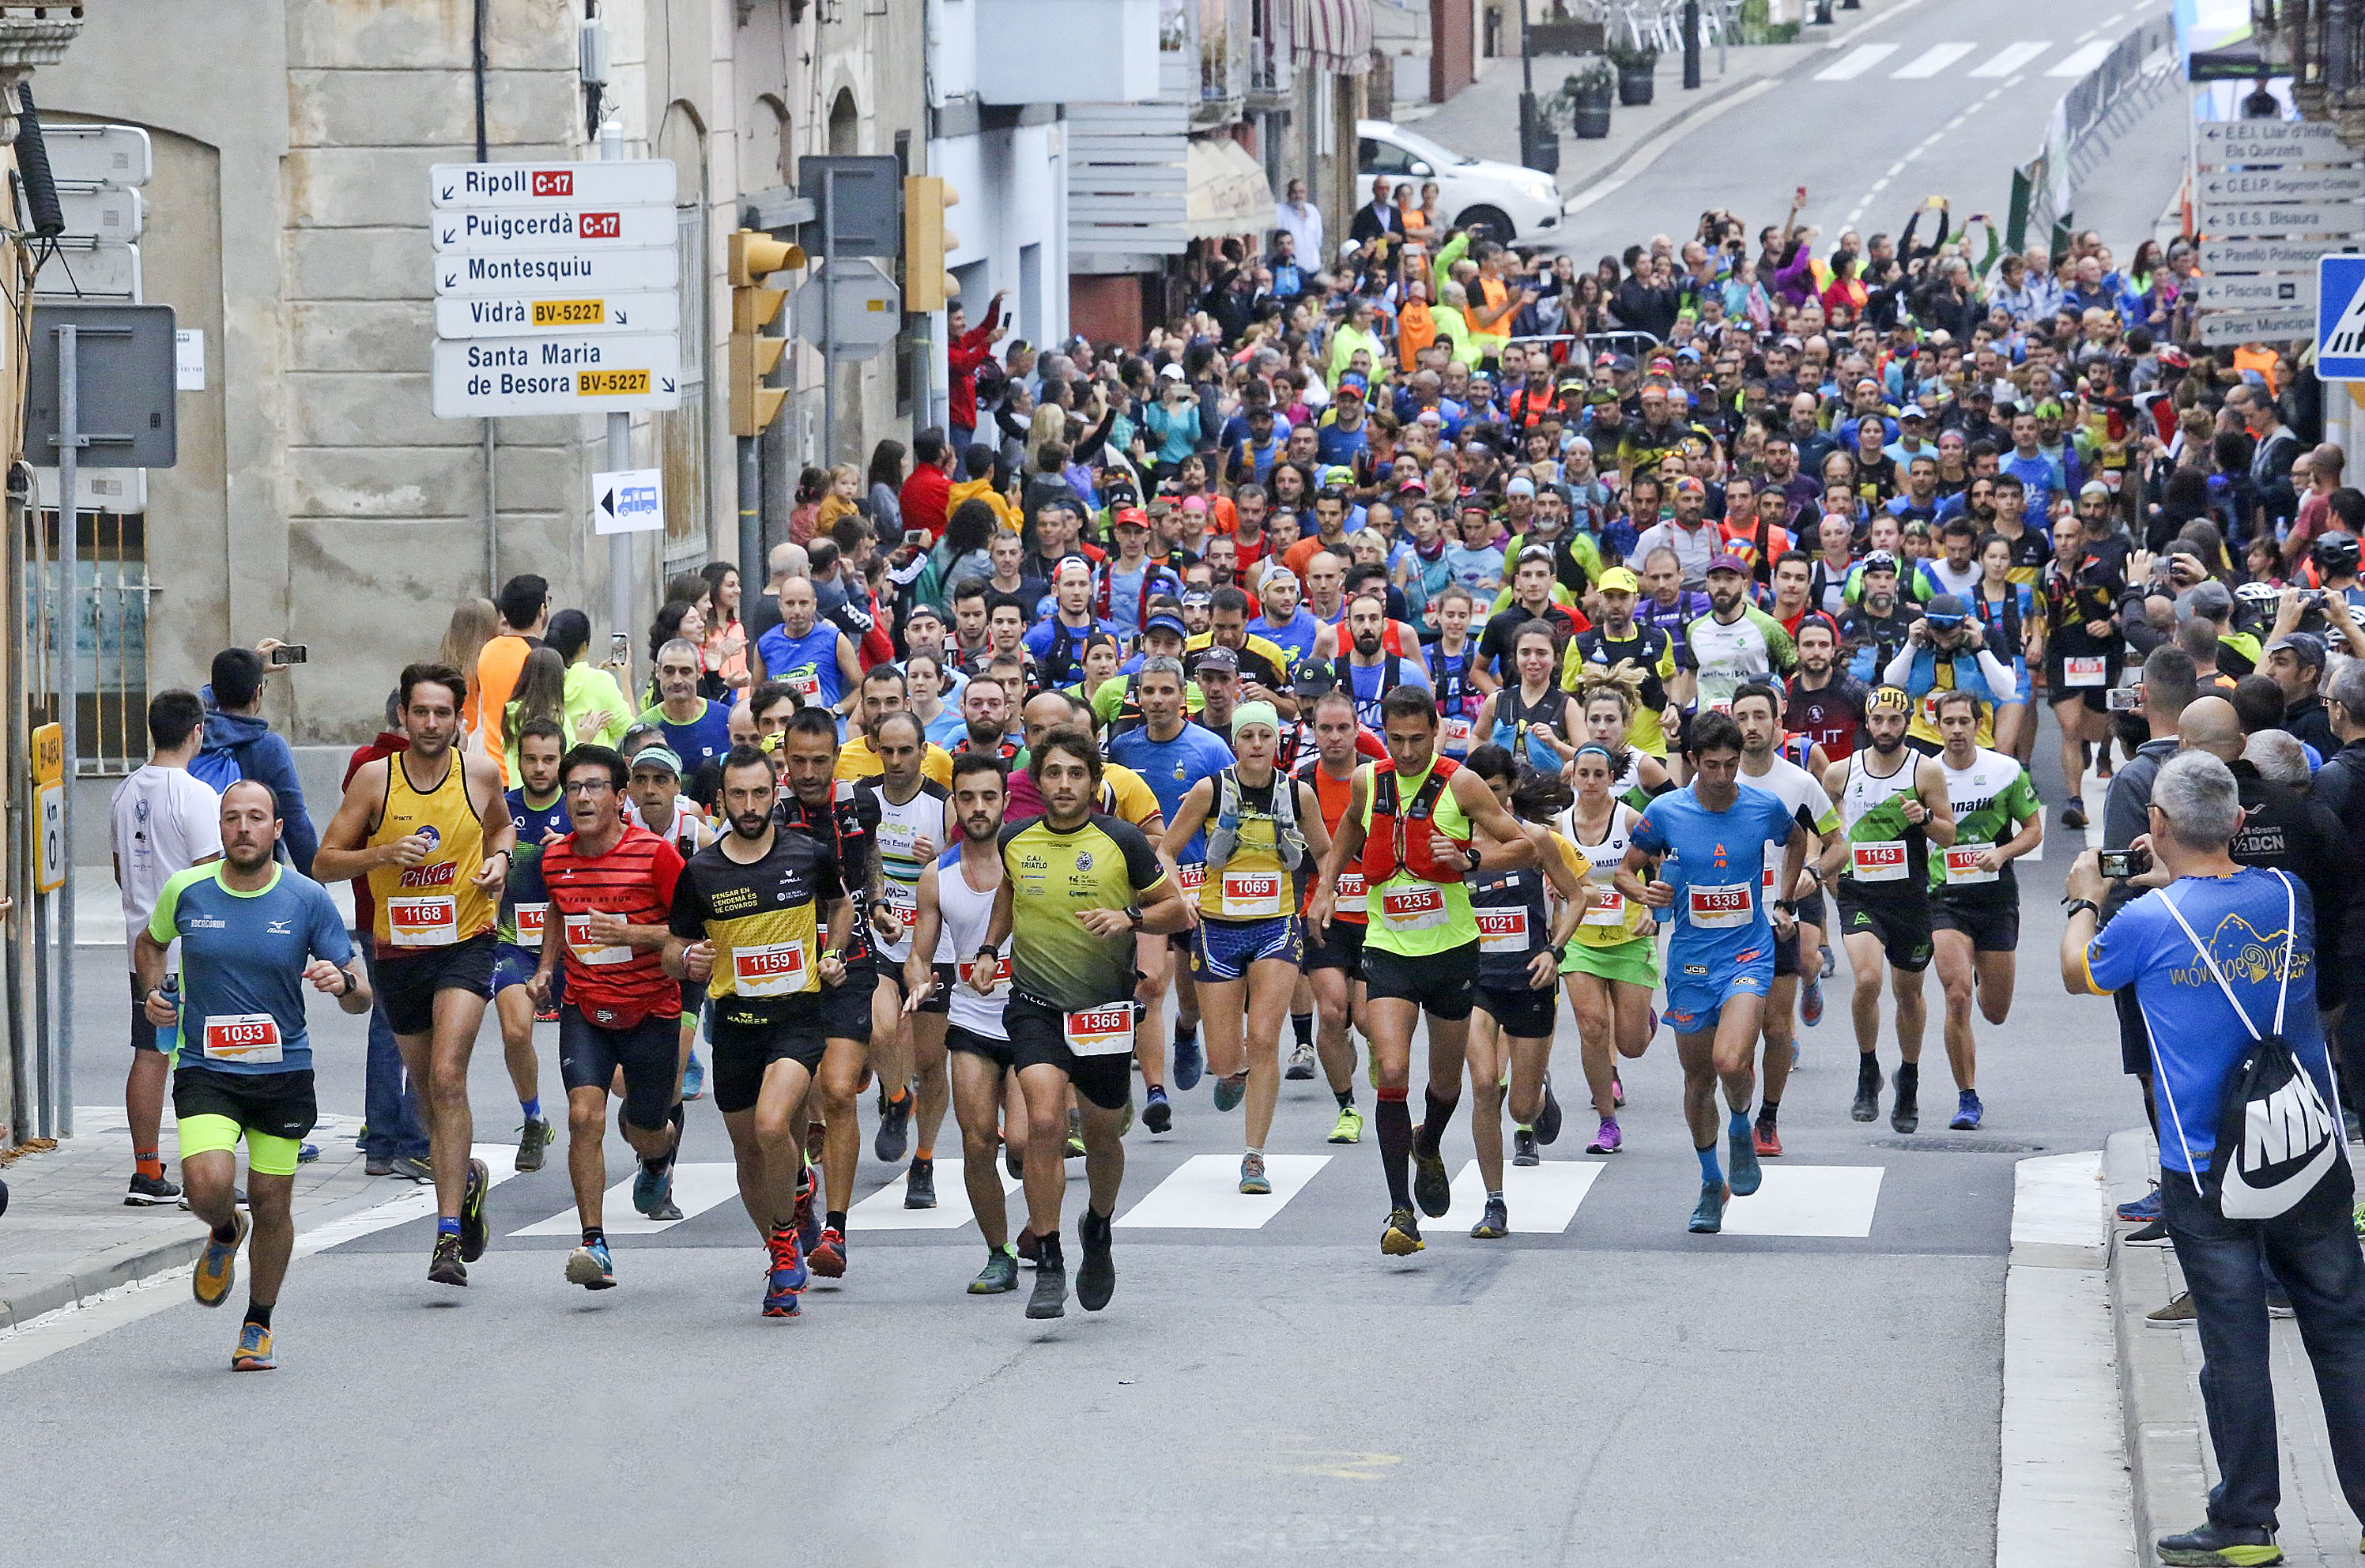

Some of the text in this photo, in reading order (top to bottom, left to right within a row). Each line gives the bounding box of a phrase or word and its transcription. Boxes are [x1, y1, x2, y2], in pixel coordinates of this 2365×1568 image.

[466, 172, 570, 195] Ripoll C-17
[466, 213, 617, 239] Puigcerdà C-17
[469, 256, 591, 281] Montesquiu
[2225, 284, 2272, 297] Piscina
[471, 301, 601, 322] Vidrà BV-5227
[2224, 320, 2252, 334] Parc
[467, 343, 601, 368] Santa Maria
[467, 374, 647, 395] de Besora BV-5227
[47, 801, 58, 822] km
[1952, 798, 1993, 812] anatik
[48, 830, 57, 870] 0
[1865, 850, 1895, 861] 1143
[711, 887, 750, 900] PENSAR EN
[1236, 881, 1269, 893] 1069
[724, 900, 758, 912] COVARDS
[748, 893, 757, 902] ÉS
[1394, 893, 1431, 910] 1235
[1703, 895, 1740, 907] 1338
[405, 906, 441, 922] 1168
[1480, 917, 1514, 929] 1021
[751, 953, 790, 971] 1159
[1081, 1012, 1120, 1029] 1366
[221, 1025, 264, 1042] 1033
